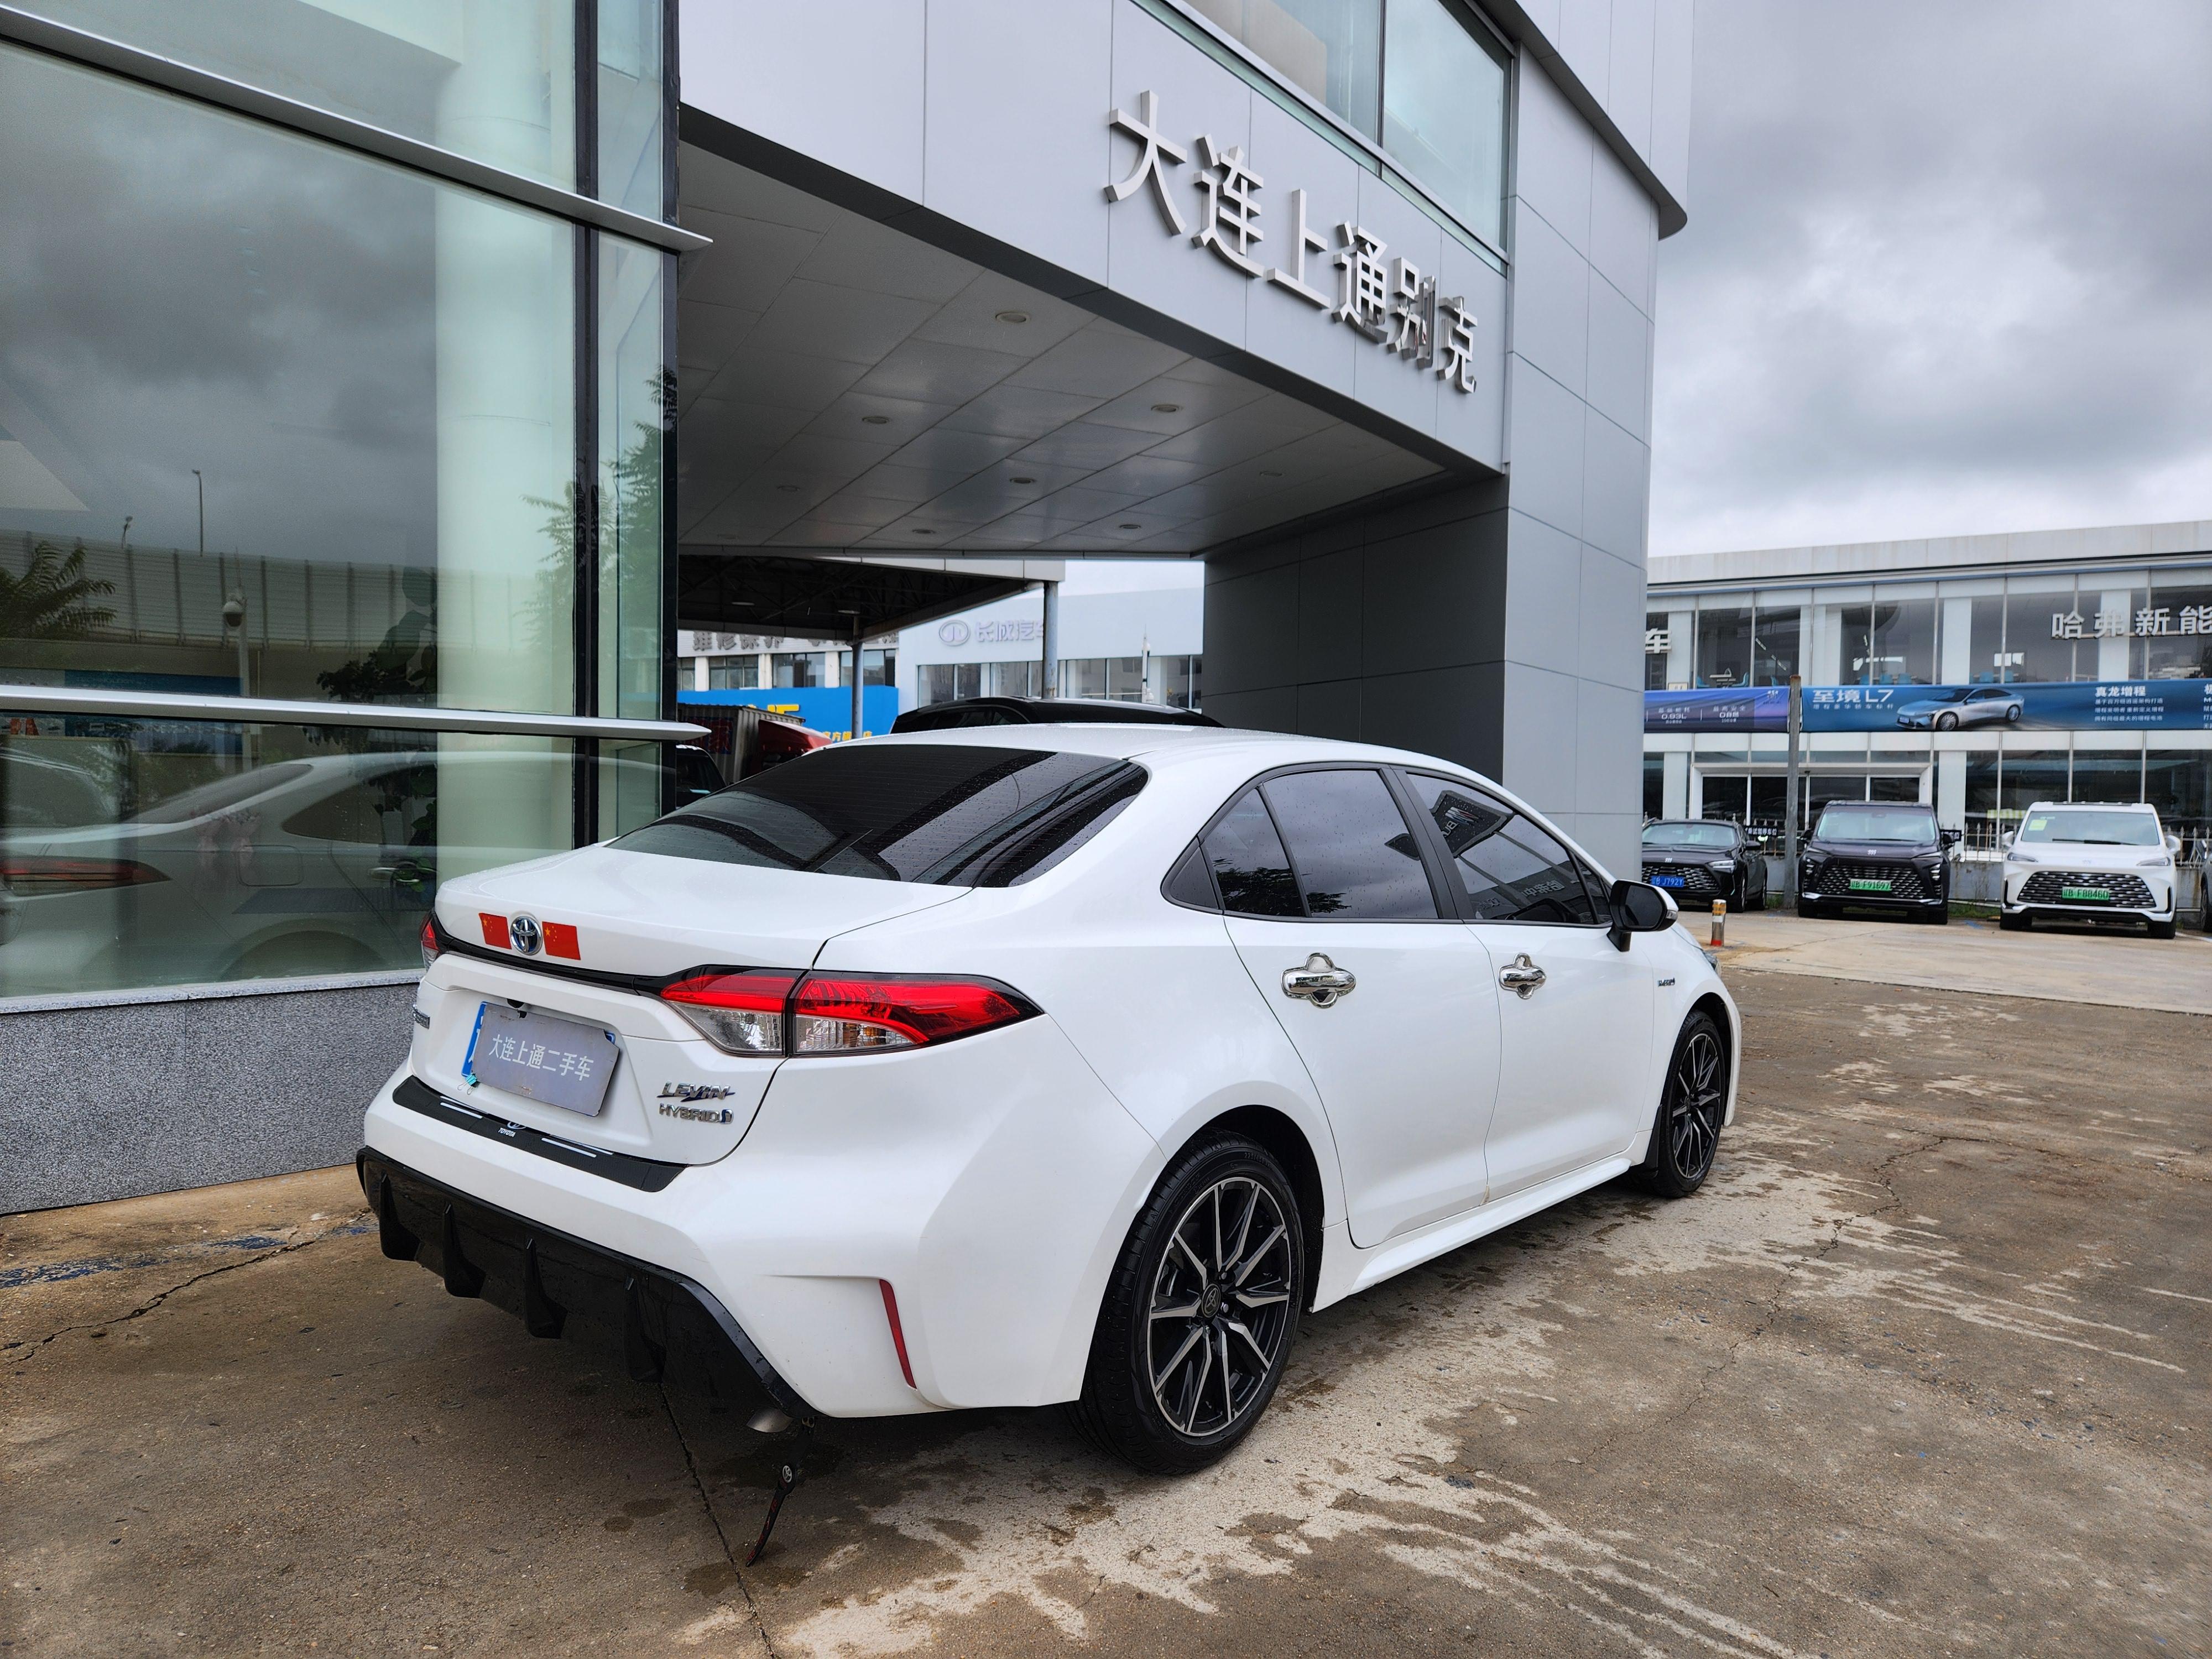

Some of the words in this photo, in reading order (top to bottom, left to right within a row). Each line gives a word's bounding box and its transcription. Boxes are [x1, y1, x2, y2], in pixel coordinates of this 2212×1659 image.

[1104, 90, 1478, 394] 大连上通别克
[2052, 606, 2212, 639] 哈弗新能
[1813, 690, 1860, 703] 至境
[1866, 690, 1893, 703] L7
[2095, 686, 2146, 697] 真龙增程
[489, 1034, 594, 1081] 大连上通二手车
[661, 1081, 731, 1100] LEVIN
[498, 1127, 516, 1138] TOYOTA
